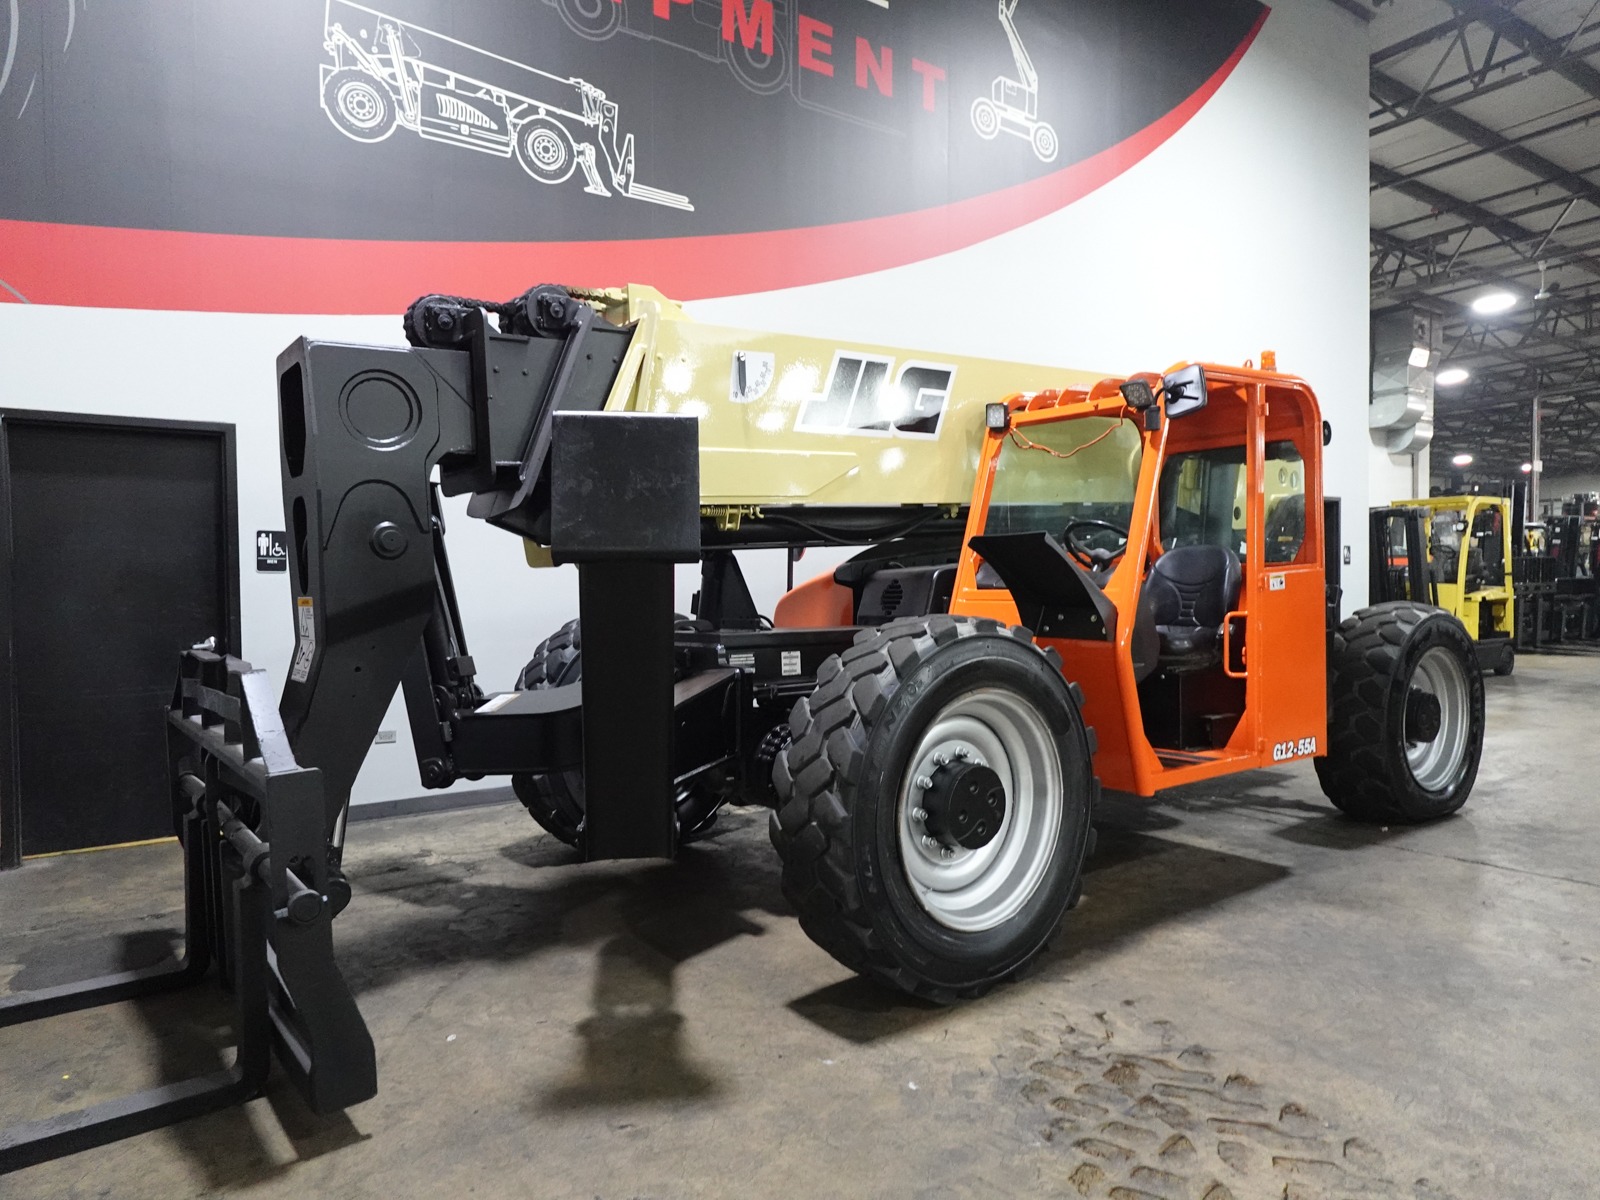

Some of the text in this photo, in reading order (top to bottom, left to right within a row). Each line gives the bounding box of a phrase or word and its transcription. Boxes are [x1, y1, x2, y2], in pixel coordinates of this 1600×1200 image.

[611, 0, 946, 113] MENT
[797, 353, 955, 438] JLG
[1272, 736, 1317, 762] G12-55A
